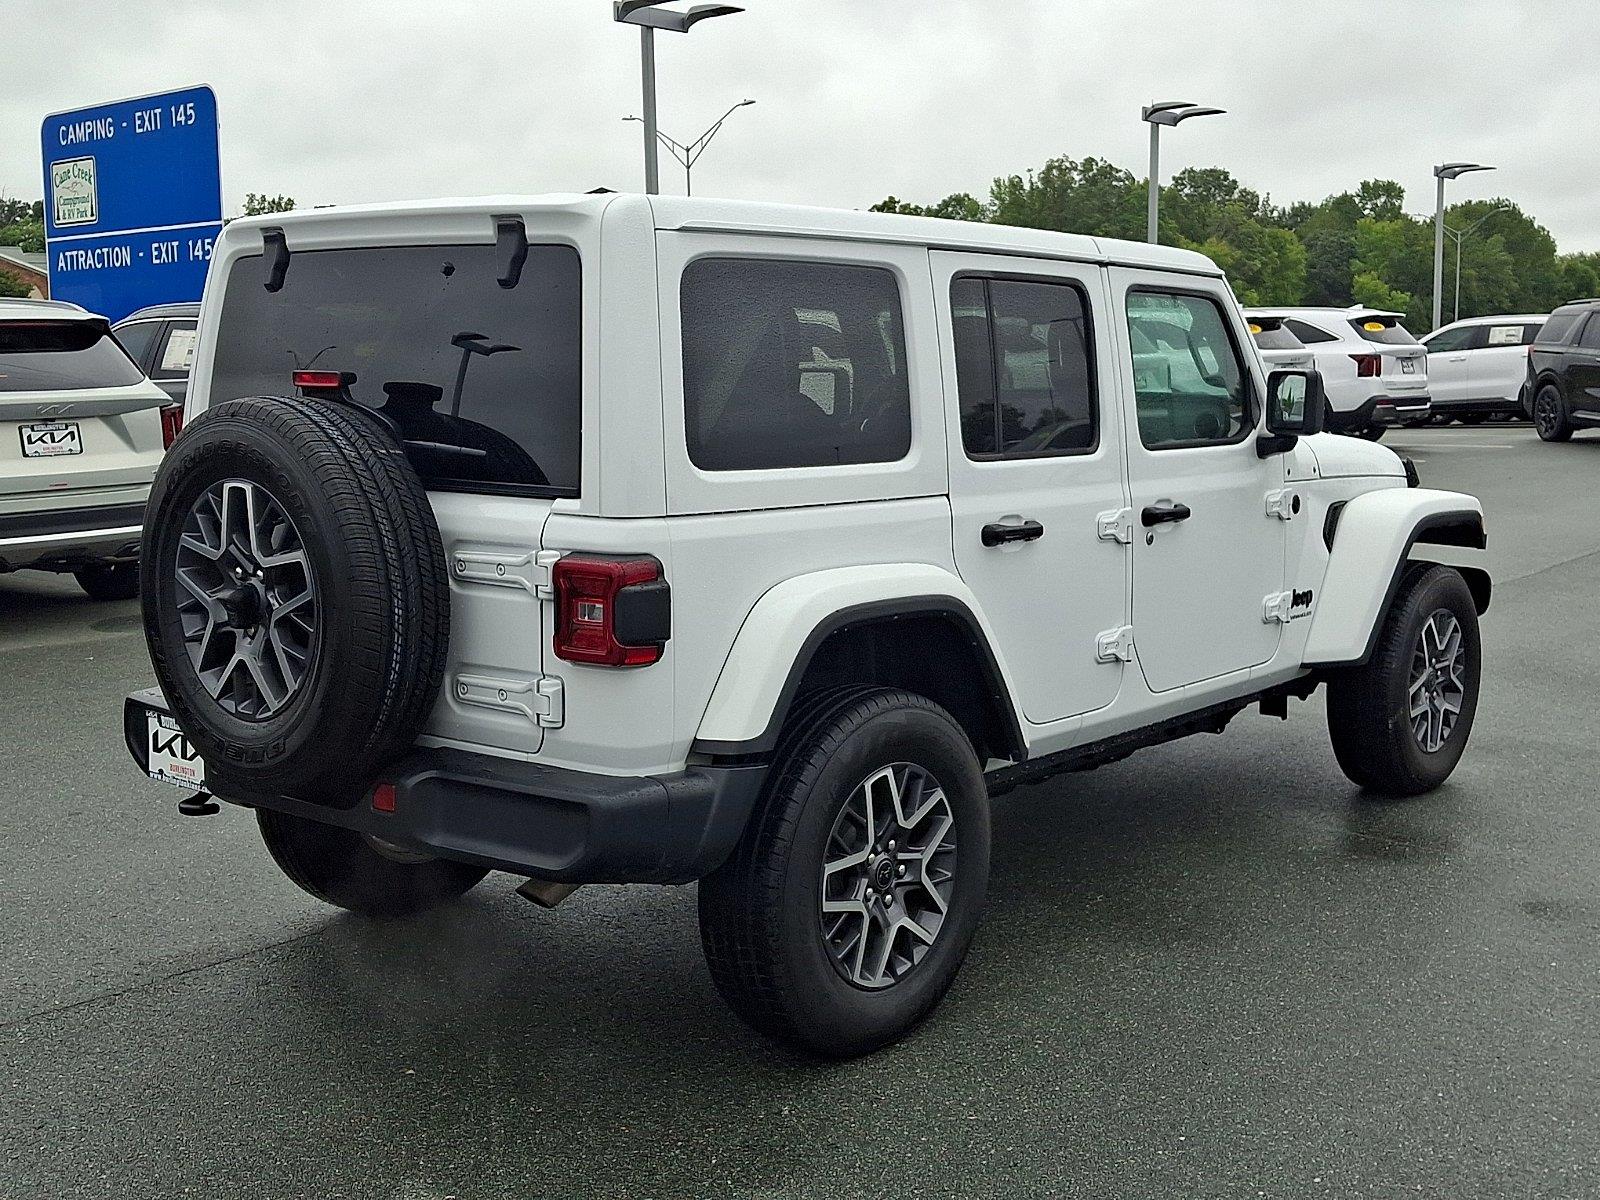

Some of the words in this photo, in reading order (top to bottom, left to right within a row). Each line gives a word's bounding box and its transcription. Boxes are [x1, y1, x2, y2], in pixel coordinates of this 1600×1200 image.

[59, 118, 115, 146] CAMPING
[135, 108, 162, 133] EXIT
[170, 102, 196, 128] 145
[55, 168, 71, 188] Cane
[72, 163, 92, 185] Creek
[59, 193, 90, 207] Campground
[67, 208, 76, 219] RV
[77, 207, 88, 219] Park
[58, 246, 131, 272] ATTRACTION
[152, 241, 178, 264] EXIT
[188, 238, 213, 261] 145
[27, 431, 75, 445] KIA
[1291, 588, 1313, 609] Jeep
